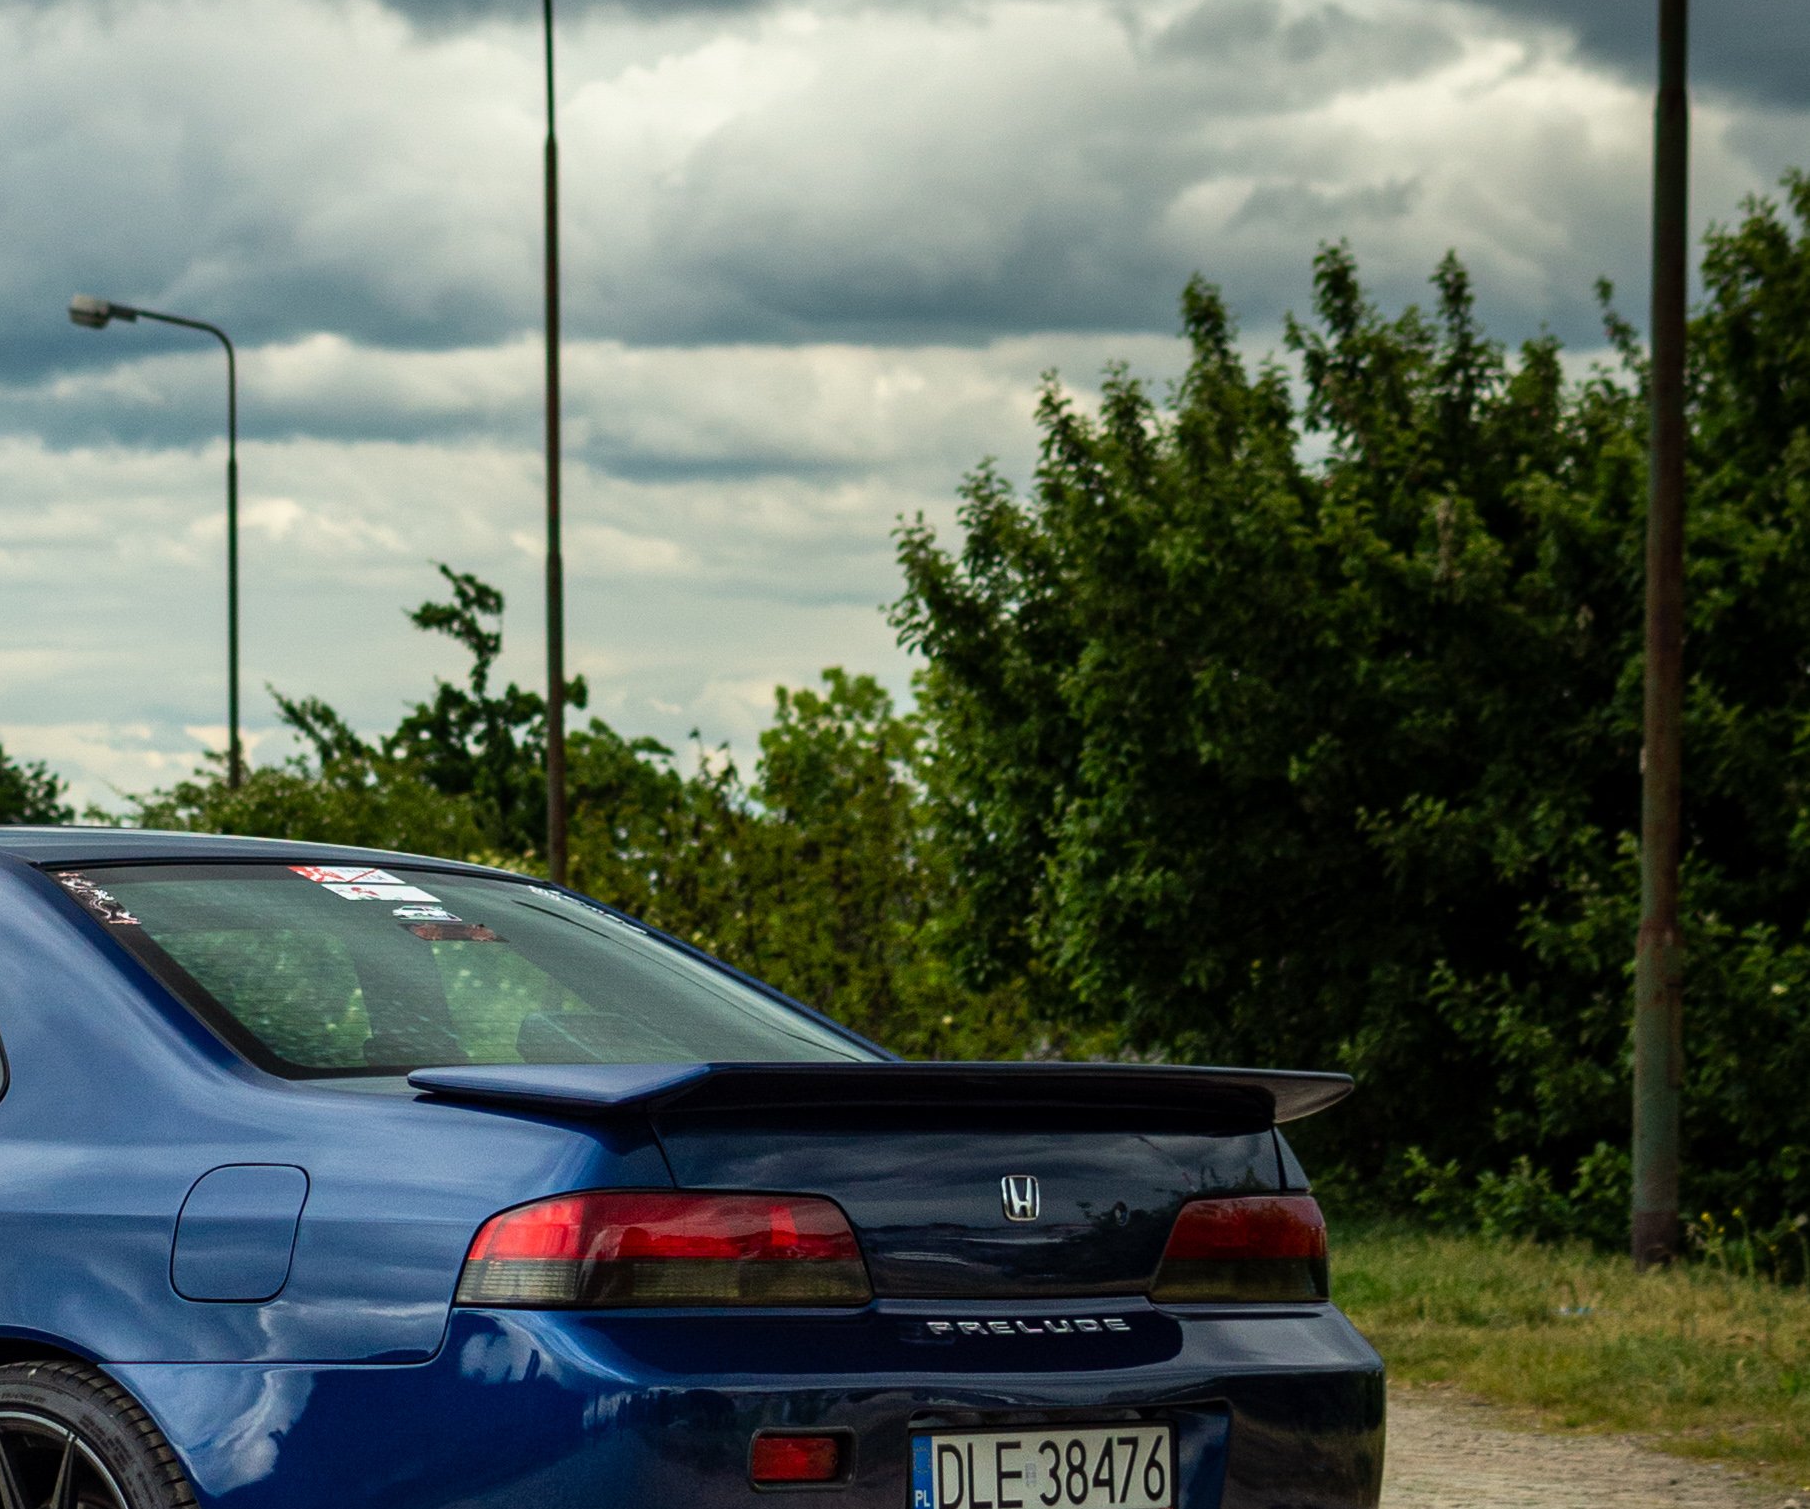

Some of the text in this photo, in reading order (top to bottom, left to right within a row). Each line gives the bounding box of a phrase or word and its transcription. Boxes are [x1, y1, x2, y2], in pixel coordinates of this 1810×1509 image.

[926, 1318, 1131, 1335] PRELUDE
[1038, 1435, 1164, 1506] 38476
[914, 1489, 931, 1508] PL
